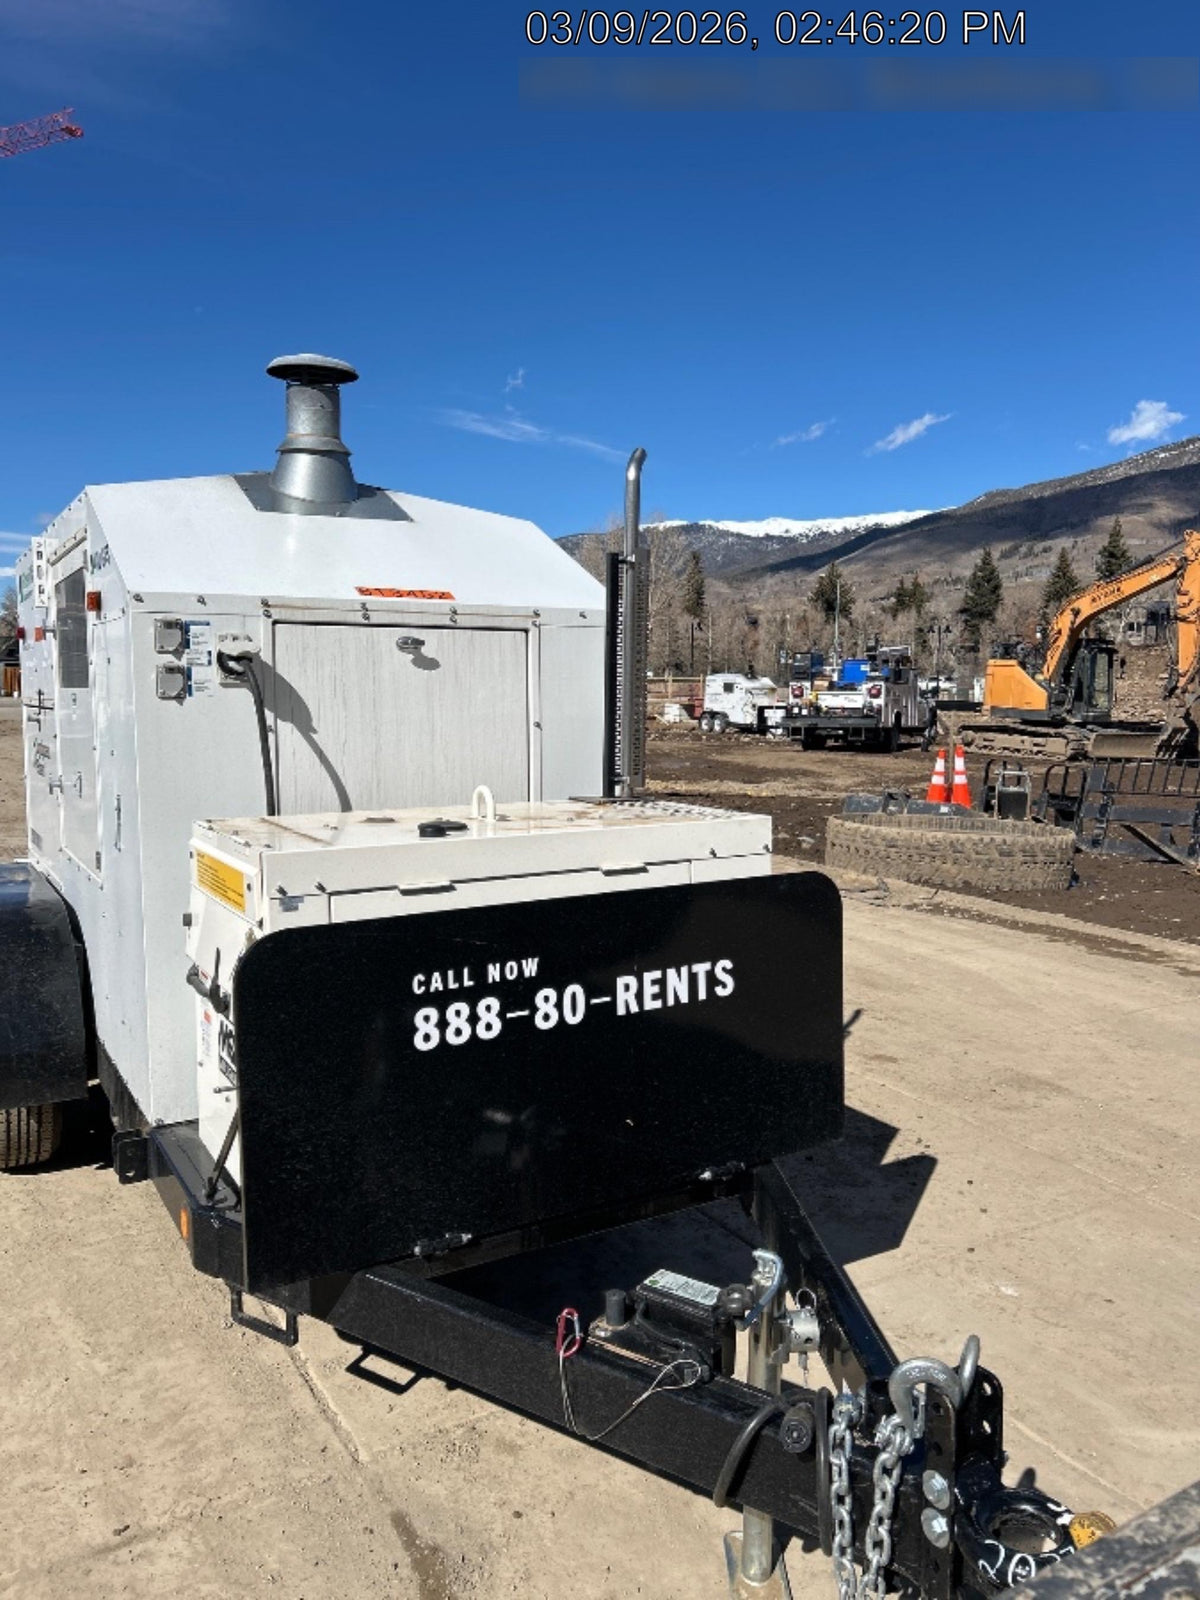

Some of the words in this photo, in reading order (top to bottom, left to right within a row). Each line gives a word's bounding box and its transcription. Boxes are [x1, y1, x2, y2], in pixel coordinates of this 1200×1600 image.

[413, 967, 475, 994] CALL
[488, 958, 540, 983] NOW
[413, 960, 735, 1051] 888-80-RENTS
